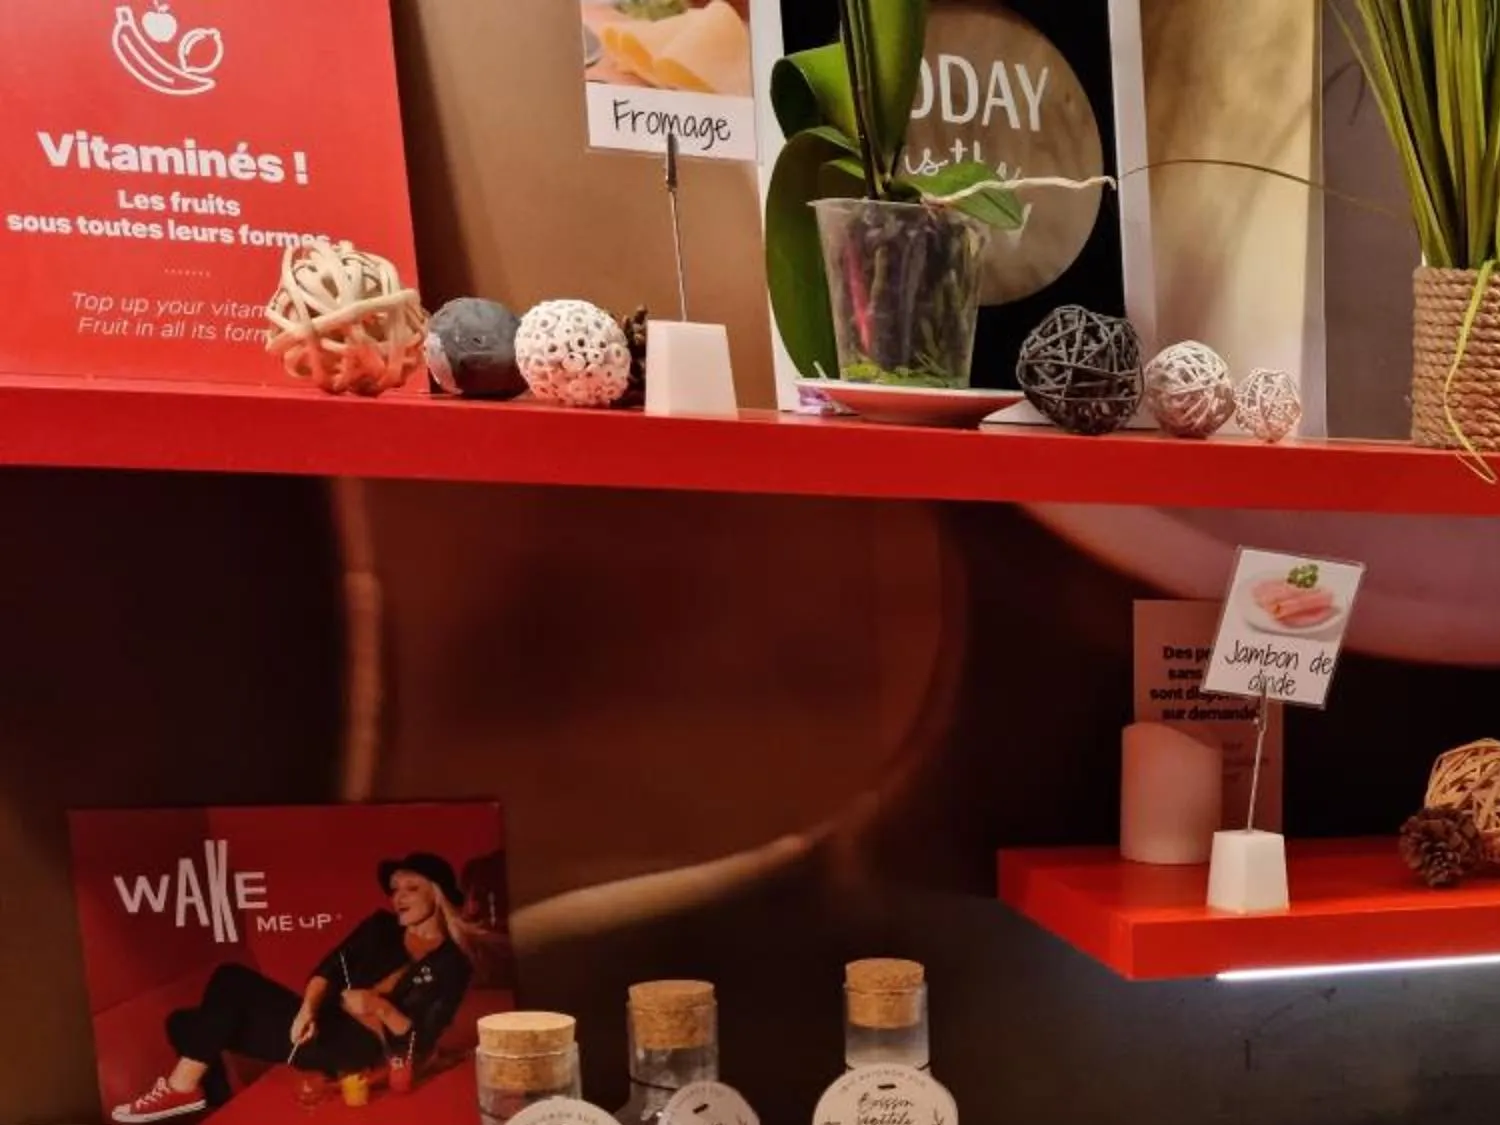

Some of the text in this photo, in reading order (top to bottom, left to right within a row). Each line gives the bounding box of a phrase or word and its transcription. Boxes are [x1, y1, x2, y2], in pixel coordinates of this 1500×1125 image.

[613, 98, 730, 150] Fromage
[37, 131, 309, 184] Vitaminés !
[117, 189, 241, 216] Les fruits
[7, 213, 72, 233] sous
[77, 216, 163, 240] toutes
[168, 220, 234, 245] leurs
[73, 291, 267, 319] Top up your vitam
[78, 315, 271, 344] Fruit in all its form
[1224, 640, 1299, 670] Jambon
[1309, 651, 1335, 675] de
[113, 839, 269, 943] WAKE
[256, 914, 293, 932] ME
